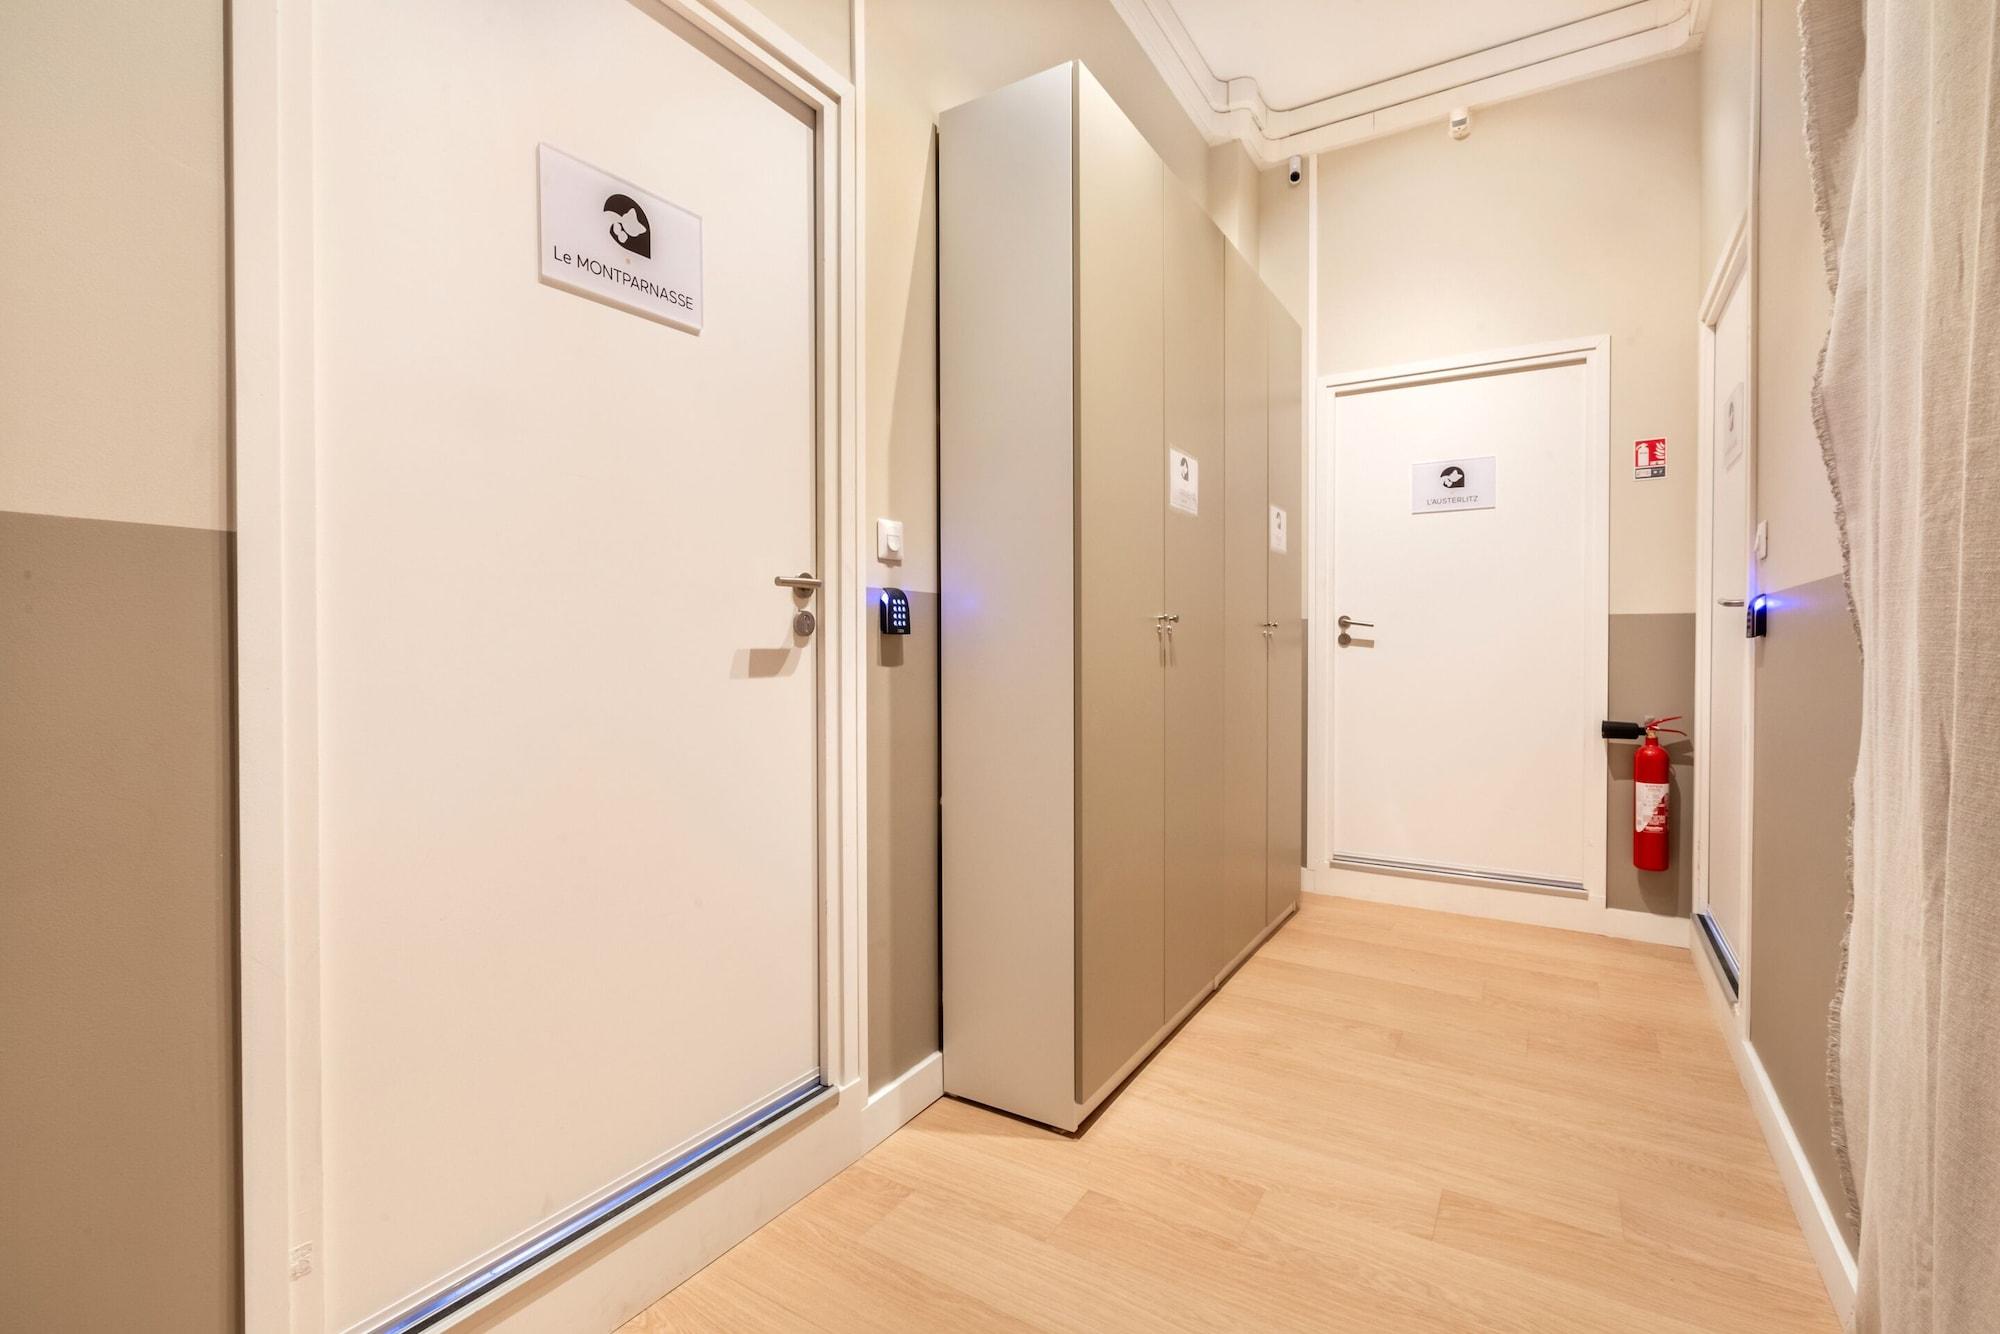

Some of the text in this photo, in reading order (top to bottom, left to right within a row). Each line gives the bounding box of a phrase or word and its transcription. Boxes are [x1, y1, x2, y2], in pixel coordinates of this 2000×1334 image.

[554, 245, 694, 311] Le MONTPARNASSE
[1426, 495, 1479, 506] L'AUSTERLITZ
